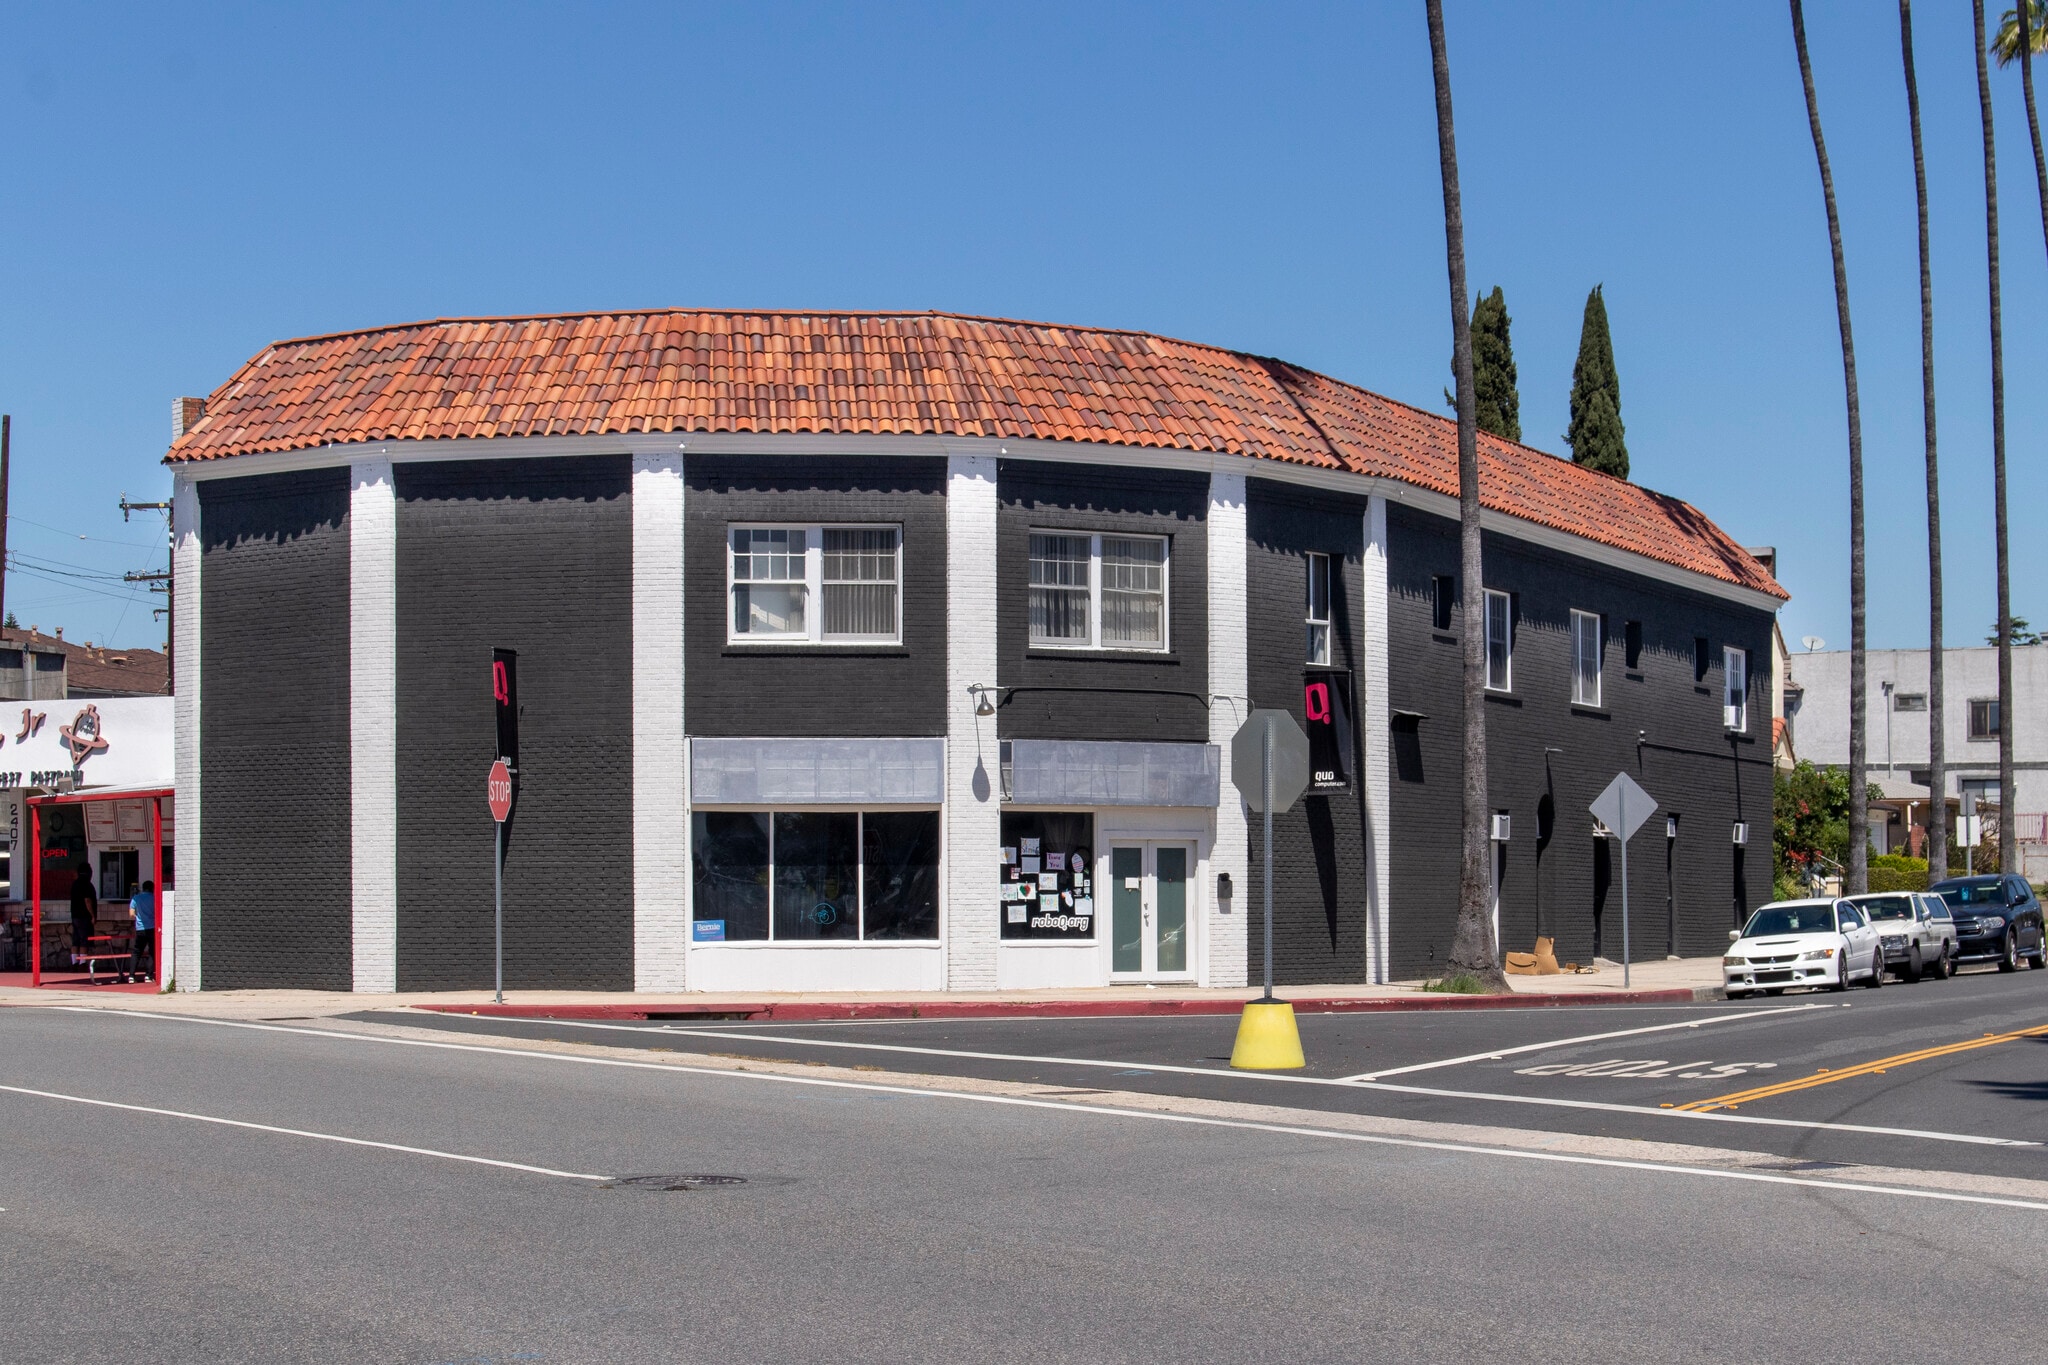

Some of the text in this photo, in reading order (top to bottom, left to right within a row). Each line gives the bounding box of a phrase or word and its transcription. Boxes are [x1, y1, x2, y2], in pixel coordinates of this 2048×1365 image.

[1315, 771, 1334, 781] QUO
[489, 781, 511, 802] STOP
[10, 804, 19, 850] 2407
[41, 848, 68, 858] OPEN
[696, 923, 721, 931] Bernie
